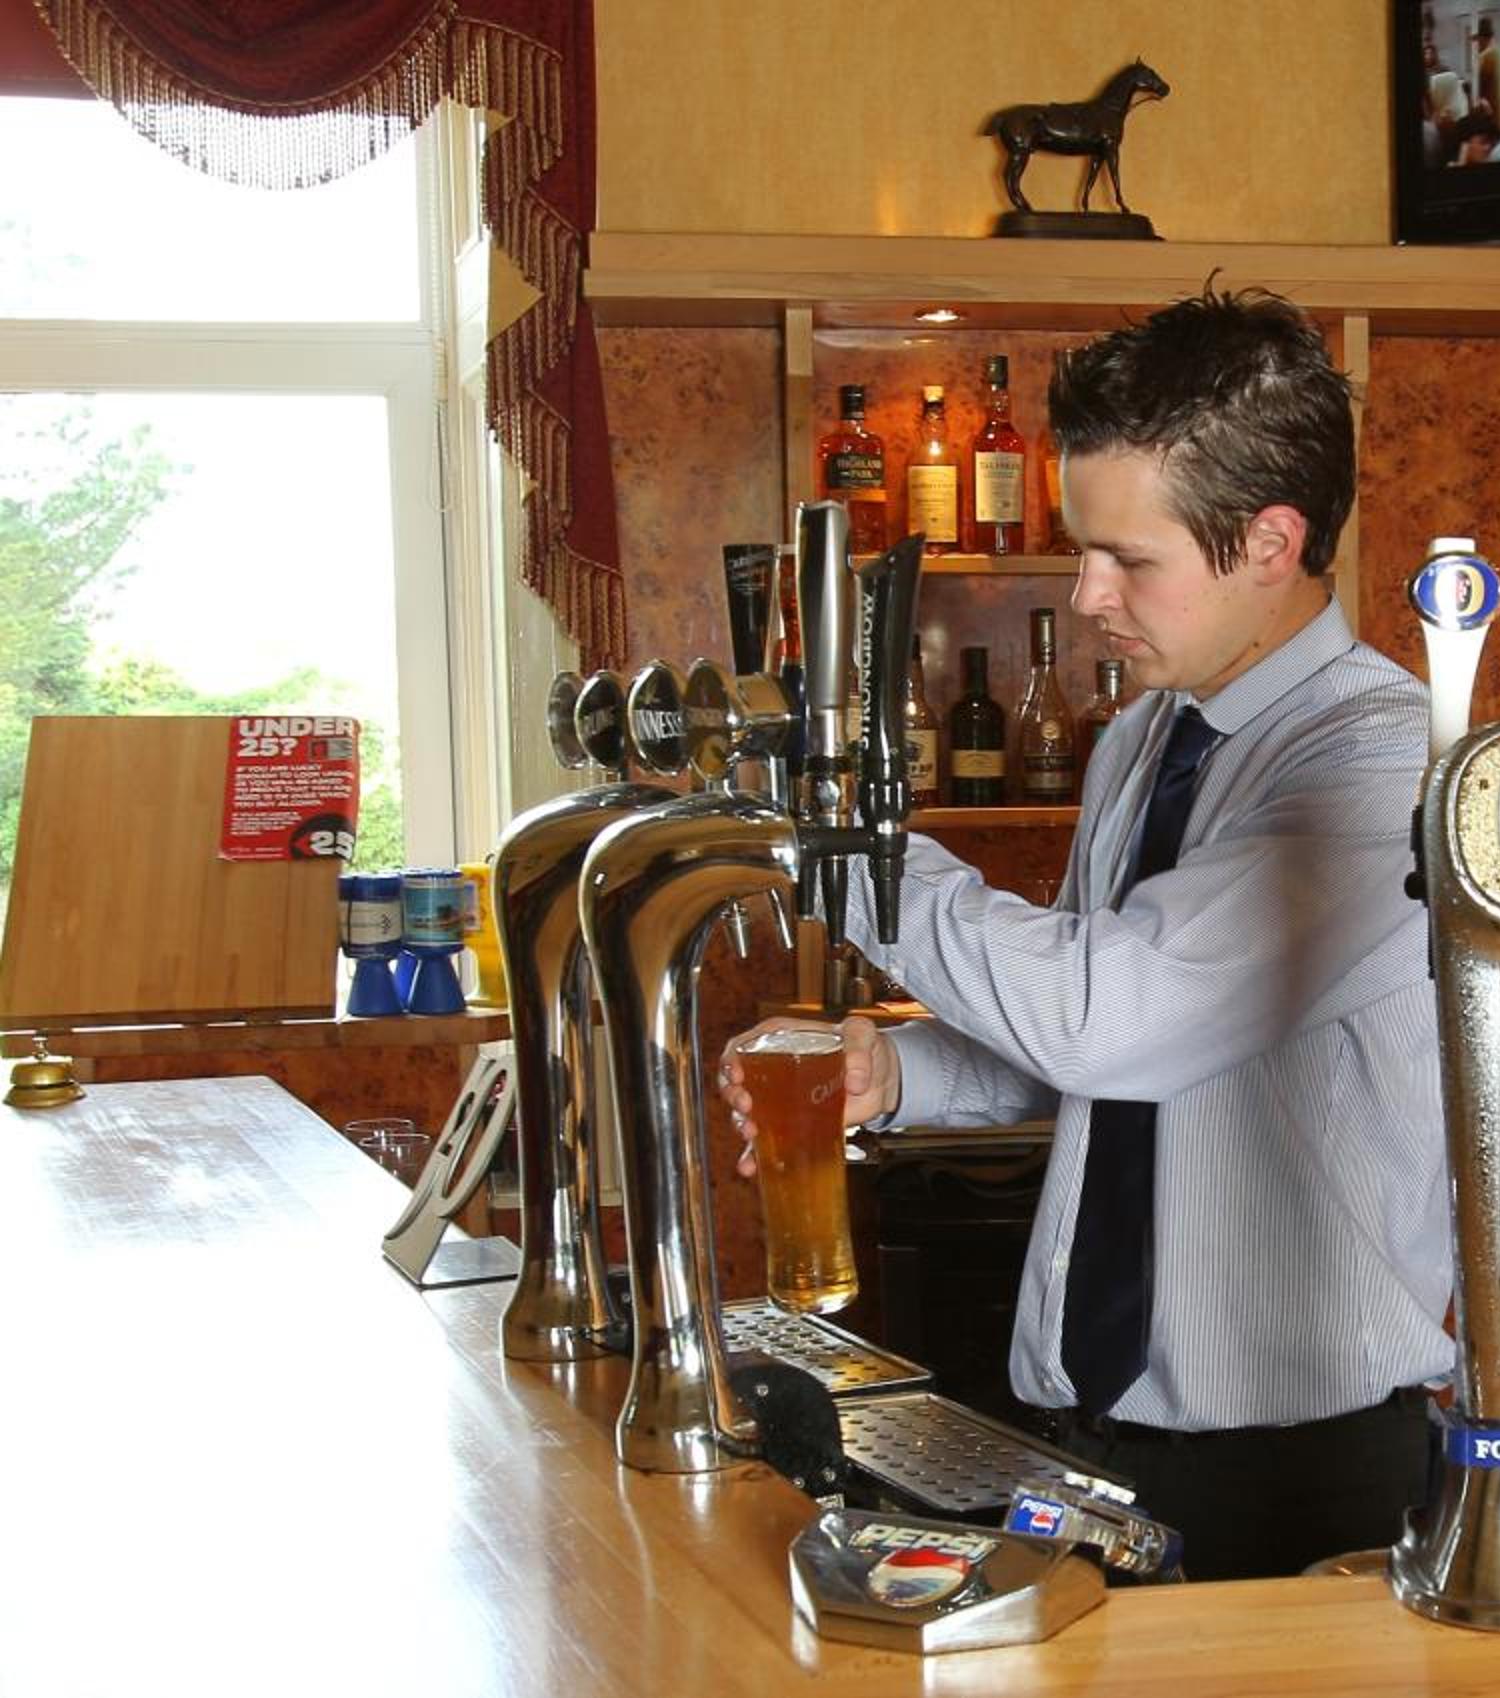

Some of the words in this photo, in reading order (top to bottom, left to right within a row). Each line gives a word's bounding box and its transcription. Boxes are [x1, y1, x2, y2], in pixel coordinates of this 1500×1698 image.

[239, 718, 352, 737] UNDER
[237, 737, 297, 758] 25?
[309, 831, 355, 861] 25
[1019, 1498, 1063, 1516] PEPSI
[856, 1524, 1000, 1565] PEPSI
